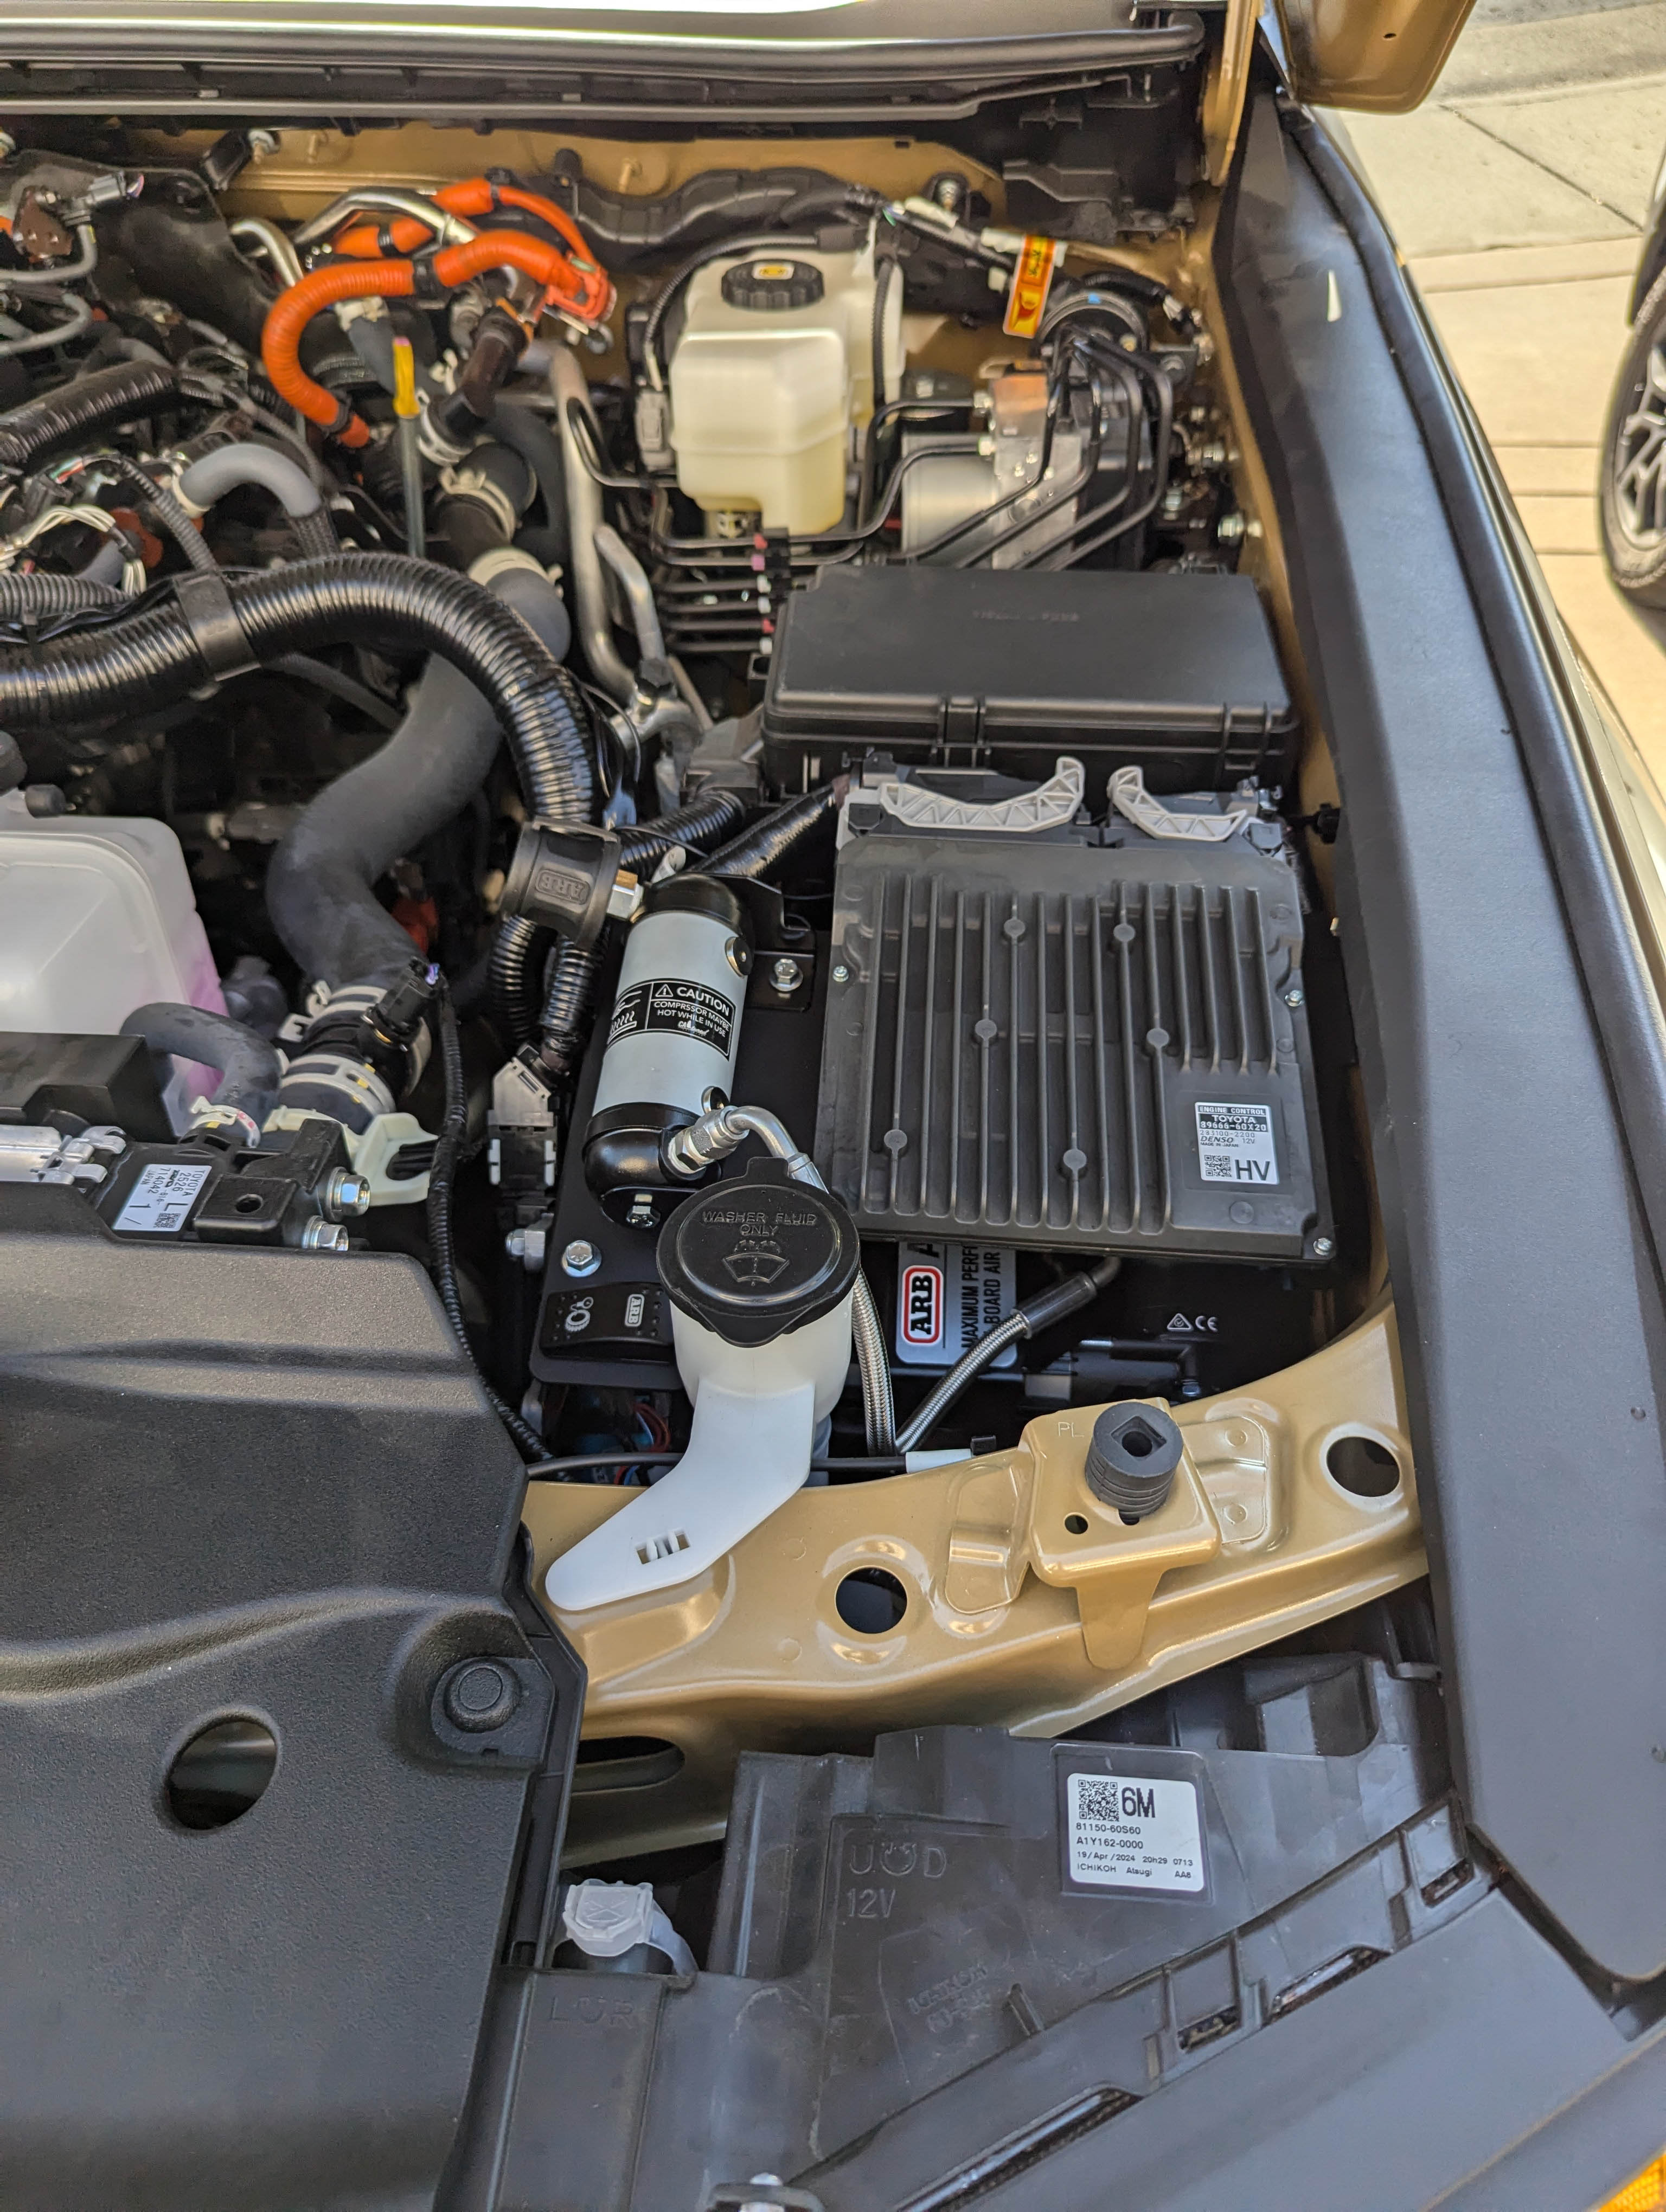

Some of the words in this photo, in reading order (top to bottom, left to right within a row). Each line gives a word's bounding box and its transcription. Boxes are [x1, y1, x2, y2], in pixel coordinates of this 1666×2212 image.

[540, 874, 584, 899] ARB
[677, 987, 729, 1016] CAUTION
[653, 1001, 707, 1015] COMPRSSOR
[708, 1012, 729, 1031] MAYBE
[677, 1011, 704, 1024] WHILE
[704, 1019, 714, 1028] IN
[714, 1024, 727, 1038] USE
[1200, 1121, 1266, 1131] 89666-60X20
[1212, 1115, 1255, 1123] TOYOTA
[1200, 1130, 1255, 1138] 283100-2200
[140, 1169, 156, 1185] JAPAN
[147, 1168, 171, 1194] 714042
[1234, 1159, 1270, 1181] HV
[172, 1173, 191, 1192] 2526
[182, 1170, 206, 1196] TOYOTA
[164, 1202, 188, 1211] L
[702, 1211, 766, 1223] WASHER
[776, 1213, 817, 1226] FLUID
[740, 1224, 778, 1236] ONLY
[962, 1246, 979, 1281] PERF
[983, 1252, 1001, 1274] AIR
[628, 1298, 642, 1323] ARB
[911, 1275, 933, 1335] ARB
[983, 1278, 1001, 1324] BOARD
[962, 1285, 979, 1348] MAXIMUM
[1121, 1786, 1156, 1818] 6M
[1076, 1822, 1141, 1835] 81150-60S60
[1077, 1836, 1143, 1849] A1Y162-0000
[1078, 1863, 1117, 1873] ICHIKOH
[1126, 1867, 1152, 1877] Atsugi
[1175, 1870, 1191, 1879] AA8
[1143, 1856, 1168, 1864] 20h29
[1173, 1858, 1193, 1867] 0713
[847, 1888, 896, 1918] 12V
